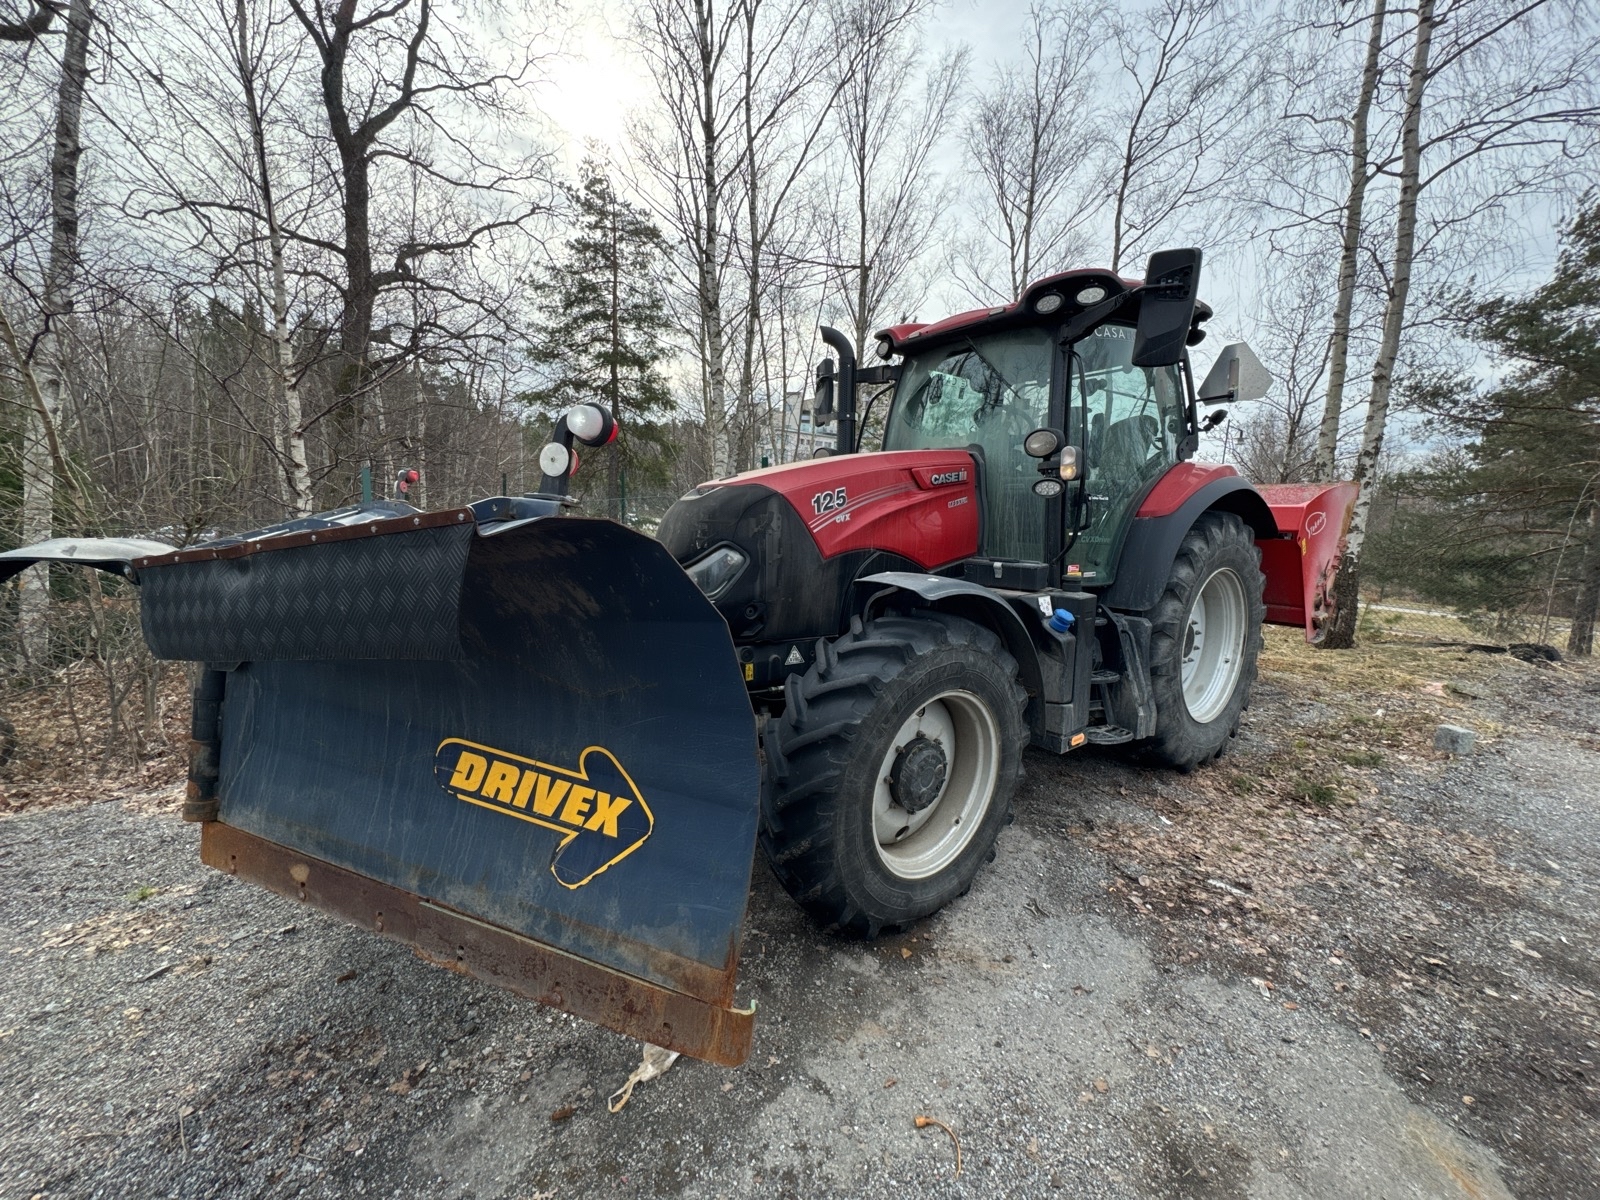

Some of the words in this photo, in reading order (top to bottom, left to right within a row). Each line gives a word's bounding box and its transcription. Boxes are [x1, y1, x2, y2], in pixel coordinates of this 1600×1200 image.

[931, 473, 958, 485] CASE
[811, 486, 847, 515] 125
[835, 513, 851, 523] CVX
[449, 750, 634, 838] DRIVEX
